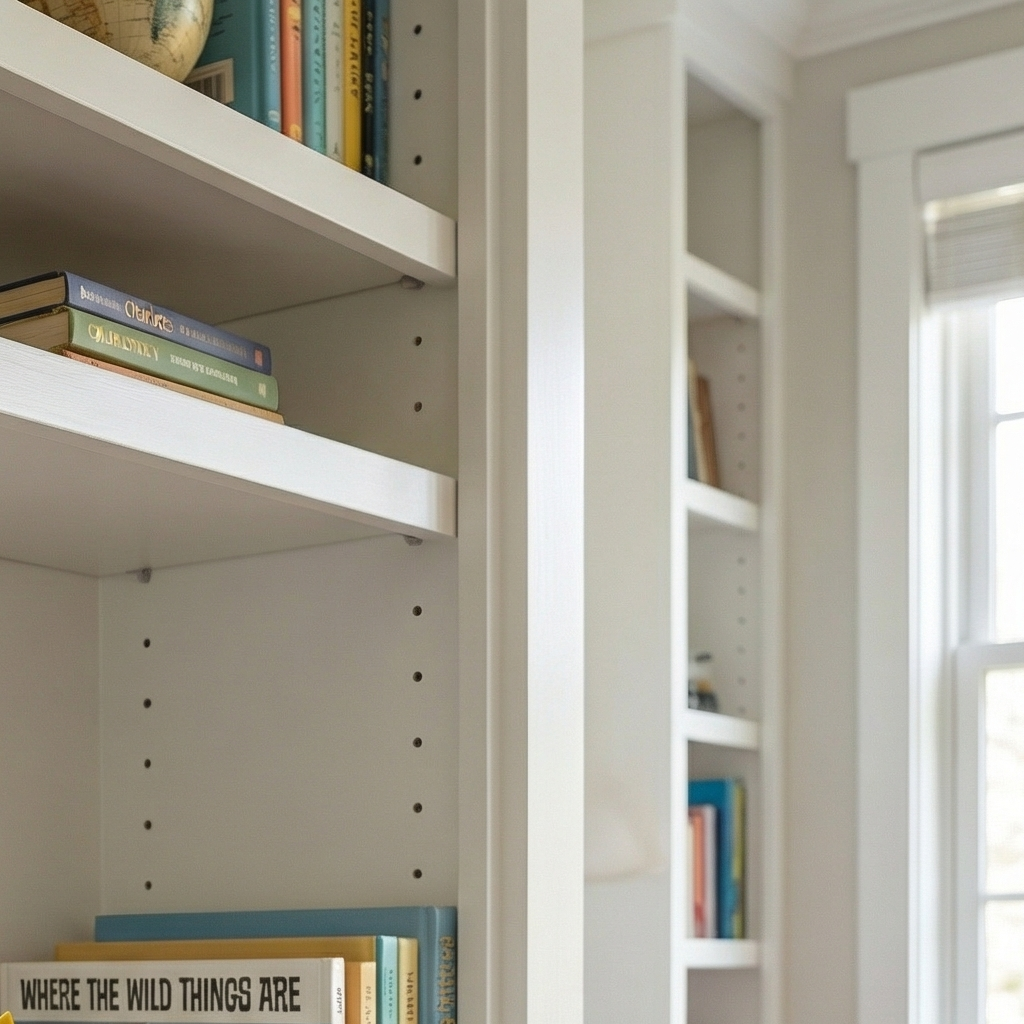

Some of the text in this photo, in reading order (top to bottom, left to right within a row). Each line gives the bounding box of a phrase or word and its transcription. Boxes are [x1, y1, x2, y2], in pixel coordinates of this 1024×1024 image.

[20, 976, 301, 1012] WHERE THE WILD THINGS ARE
